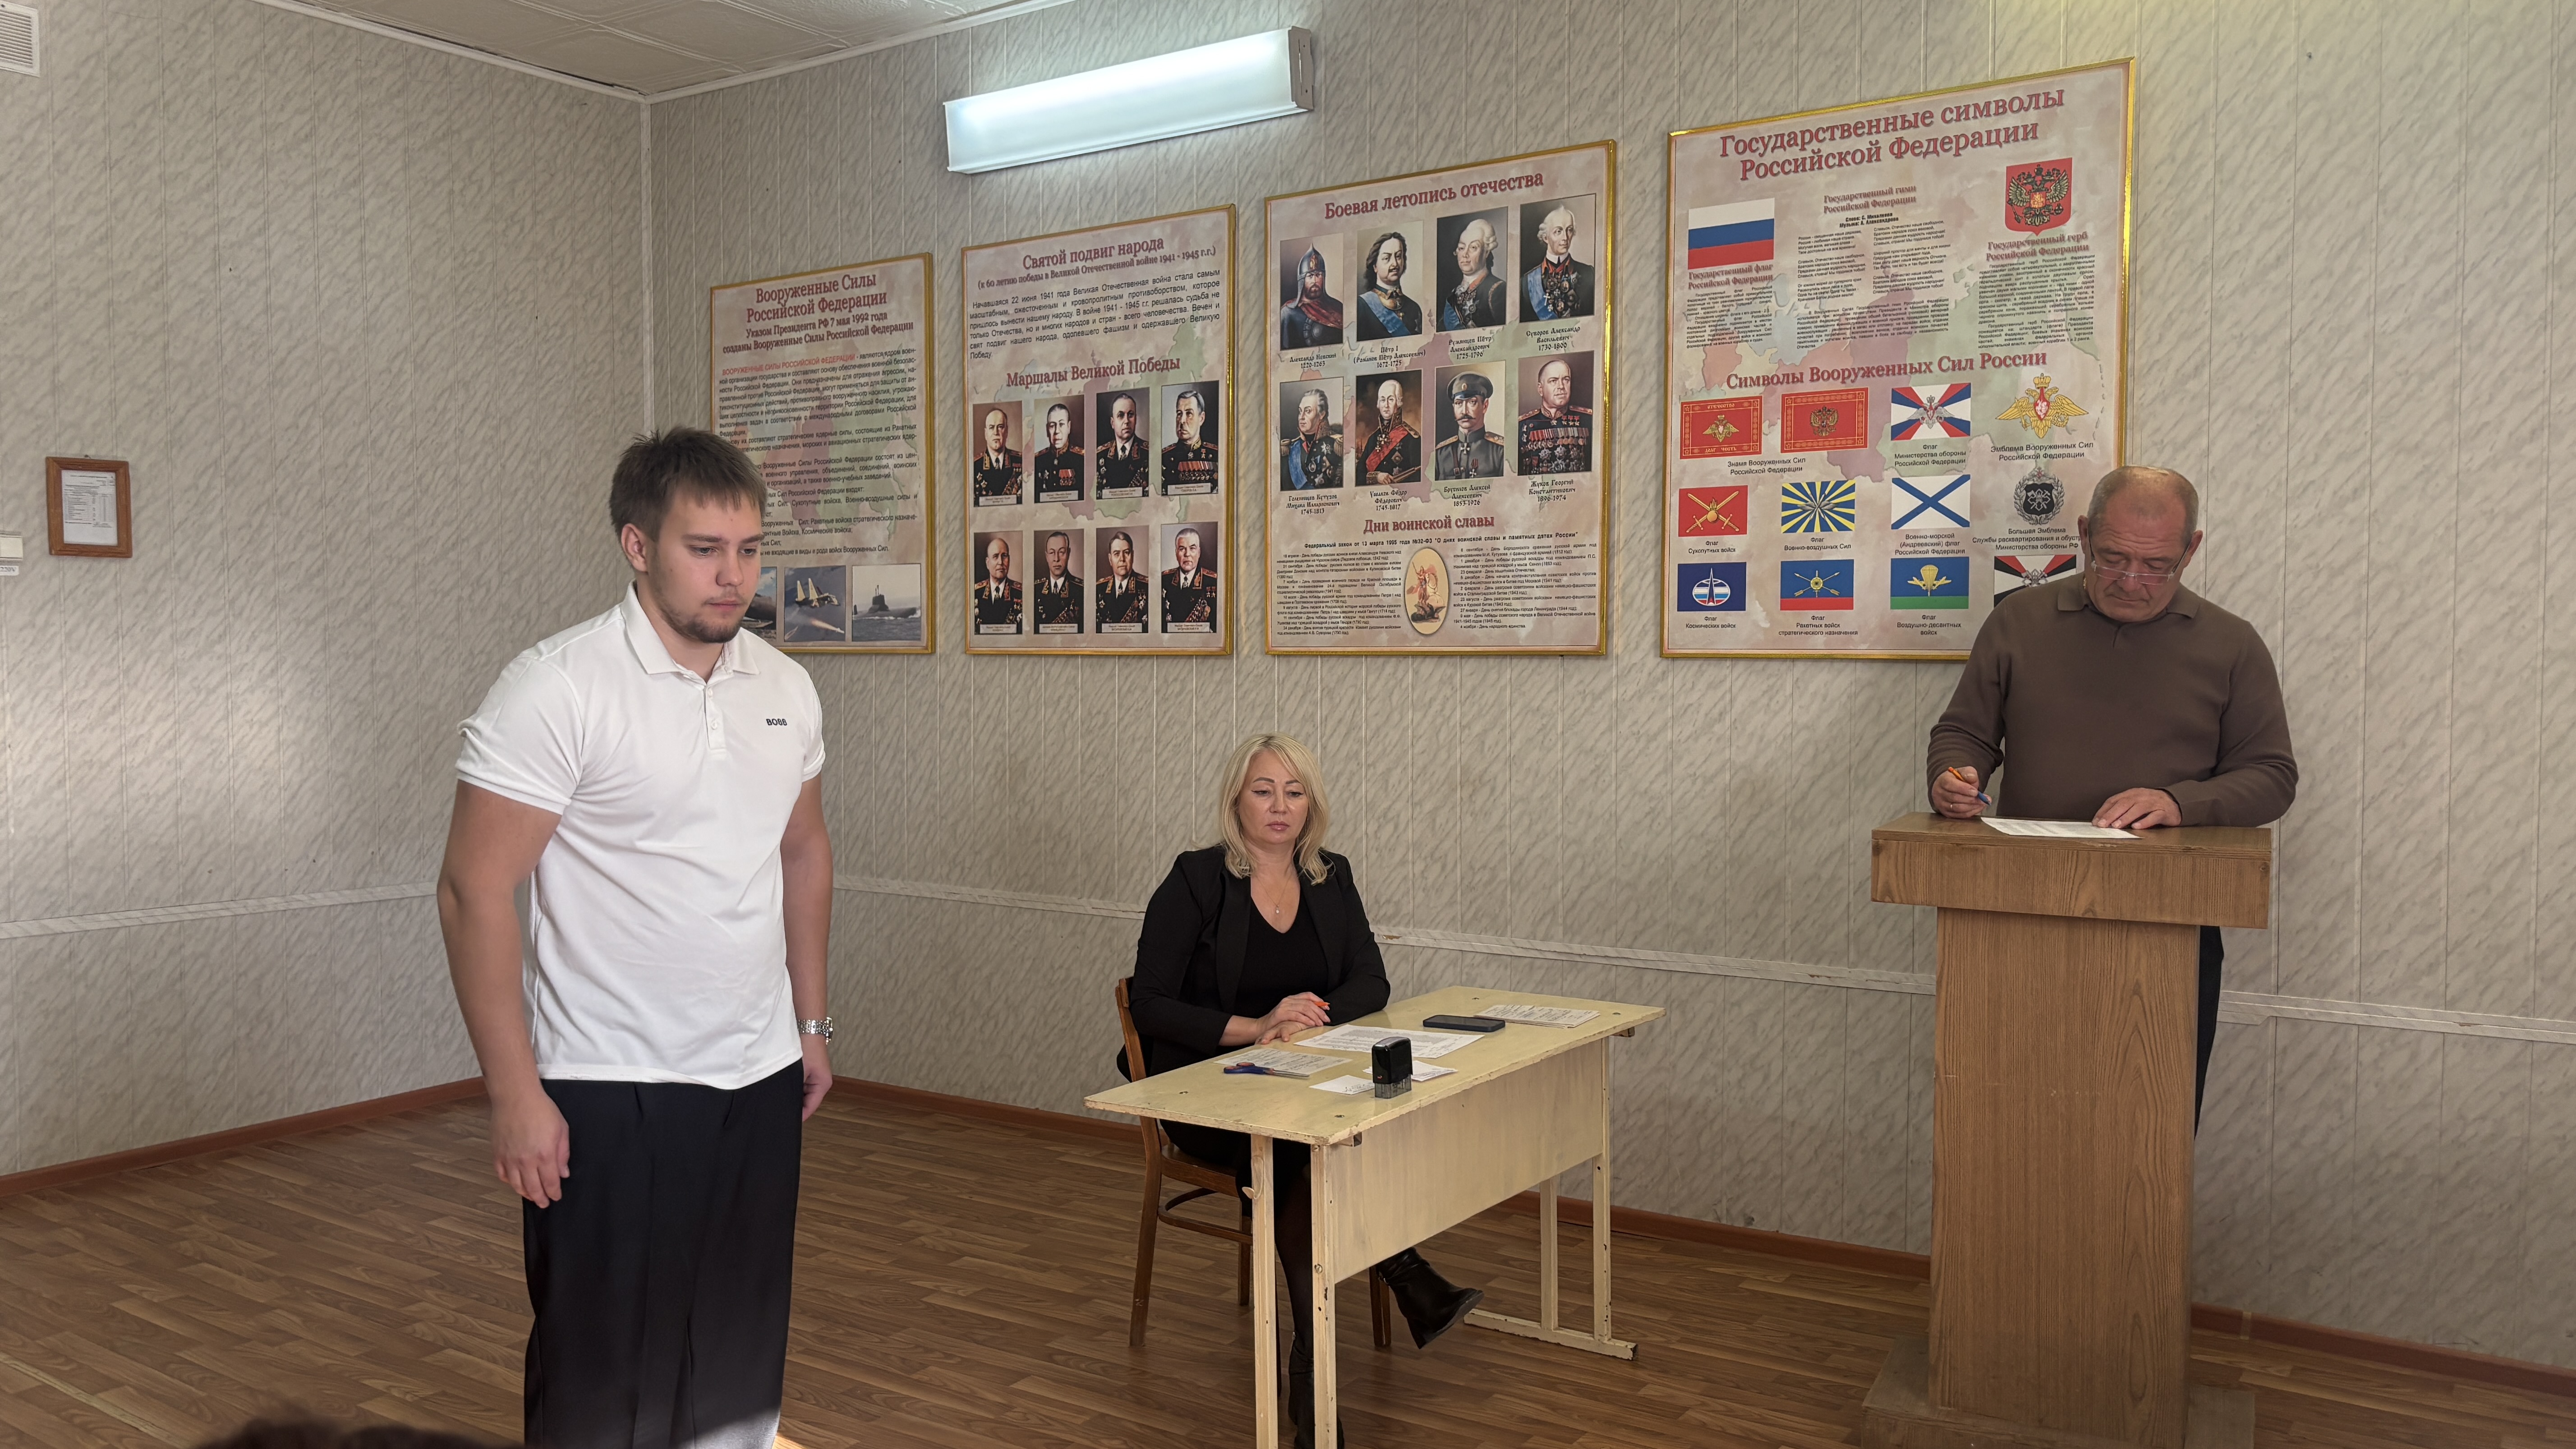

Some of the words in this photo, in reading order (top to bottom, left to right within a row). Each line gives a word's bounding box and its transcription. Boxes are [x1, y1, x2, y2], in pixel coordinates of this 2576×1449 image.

[1720, 110, 1934, 157] Государственные
[1941, 89, 2064, 124] символы
[1740, 139, 1881, 181] Российской
[1889, 123, 2038, 159] Федерации
[1325, 200, 1378, 219] Боевая
[1382, 188, 1457, 210] летопись
[1461, 173, 1543, 198] отечества
[1988, 234, 2065, 251] Государственный
[2067, 231, 2088, 243] герб
[1023, 249, 1066, 270] Святой
[1070, 246, 1115, 263] подвиг
[1118, 239, 1164, 258] народа
[1986, 248, 2037, 262] Российской
[2038, 245, 2089, 256] Федерации
[978, 281, 984, 290] (к
[986, 279, 995, 288] 60
[995, 277, 1018, 286] летию
[1019, 273, 1043, 283] победы
[1050, 266, 1080, 279] Великой
[1081, 258, 1135, 274] Отечественной
[1136, 255, 1158, 266] войне
[1159, 254, 1175, 263] 1941
[1182, 250, 1199, 260] 1945
[1201, 245, 1216, 257] г.г.)
[1689, 266, 1753, 280] Государственный
[1754, 265, 1773, 274] флаг
[756, 281, 839, 304] Вооруженные
[842, 275, 876, 290] Силы
[973, 299, 1008, 308] Начавшаяся
[1011, 296, 1019, 304] 22
[1040, 291, 1053, 300] 1941
[1073, 286, 1099, 296] Великая
[1102, 280, 1149, 291] Отечественная
[1152, 275, 1171, 285] война
[1174, 273, 1194, 281] стала
[1196, 269, 1220, 278] самым
[1688, 278, 1730, 290] Российской
[1732, 275, 1774, 285] Федерации
[747, 299, 814, 322] Российской
[818, 293, 887, 313] Федерации
[970, 309, 1010, 319] масштабным,
[1014, 303, 1058, 313] ожесточенным
[1072, 294, 1123, 307] кровопролитным
[1128, 285, 1187, 299] противоборством,
[1193, 281, 1219, 290] которое
[746, 328, 772, 338] Указом
[774, 322, 816, 336] Президента
[818, 319, 829, 329] РФ
[830, 318, 834, 327] 7
[836, 317, 851, 327] мая
[852, 314, 869, 324] 1992
[871, 313, 888, 322] года
[1550, 326, 1581, 334] Александр
[723, 344, 751, 354] созданы
[754, 337, 803, 350] Вооруженные
[804, 334, 824, 343] Силы
[827, 327, 869, 340] Российской
[871, 322, 913, 335] Федерации
[1536, 335, 1569, 343] Васильевич
[1539, 342, 1567, 351] 1730-1800
[722, 365, 763, 376] ВООРУЖЕННЫЕ
[764, 363, 781, 371] СИЛЫ
[782, 358, 819, 368] РОССИЙСКОЙ
[821, 354, 855, 363] ФЕДЕРАЦИИ
[859, 352, 884, 360] являются
[884, 350, 901, 358] ядром
[1377, 359, 1402, 368] 1672-1725
[1457, 351, 1483, 360] 1725-1796
[1007, 371, 1067, 387] Маршалы
[1071, 360, 1124, 380] Великой
[1128, 357, 1180, 374] Победы
[1726, 372, 1803, 389] Символы
[1809, 362, 1933, 384] Вооруженных
[1938, 356, 1973, 373] Сил
[1980, 353, 2047, 369] России
[1999, 452, 2040, 461] Российской
[2025, 443, 2076, 453] Вооруженных
[1894, 459, 1930, 469] Российской
[1537, 494, 1566, 502] 1896-1974
[1363, 520, 1389, 534] Дни
[1392, 515, 1452, 531] воинской
[1455, 517, 1494, 528] славы
